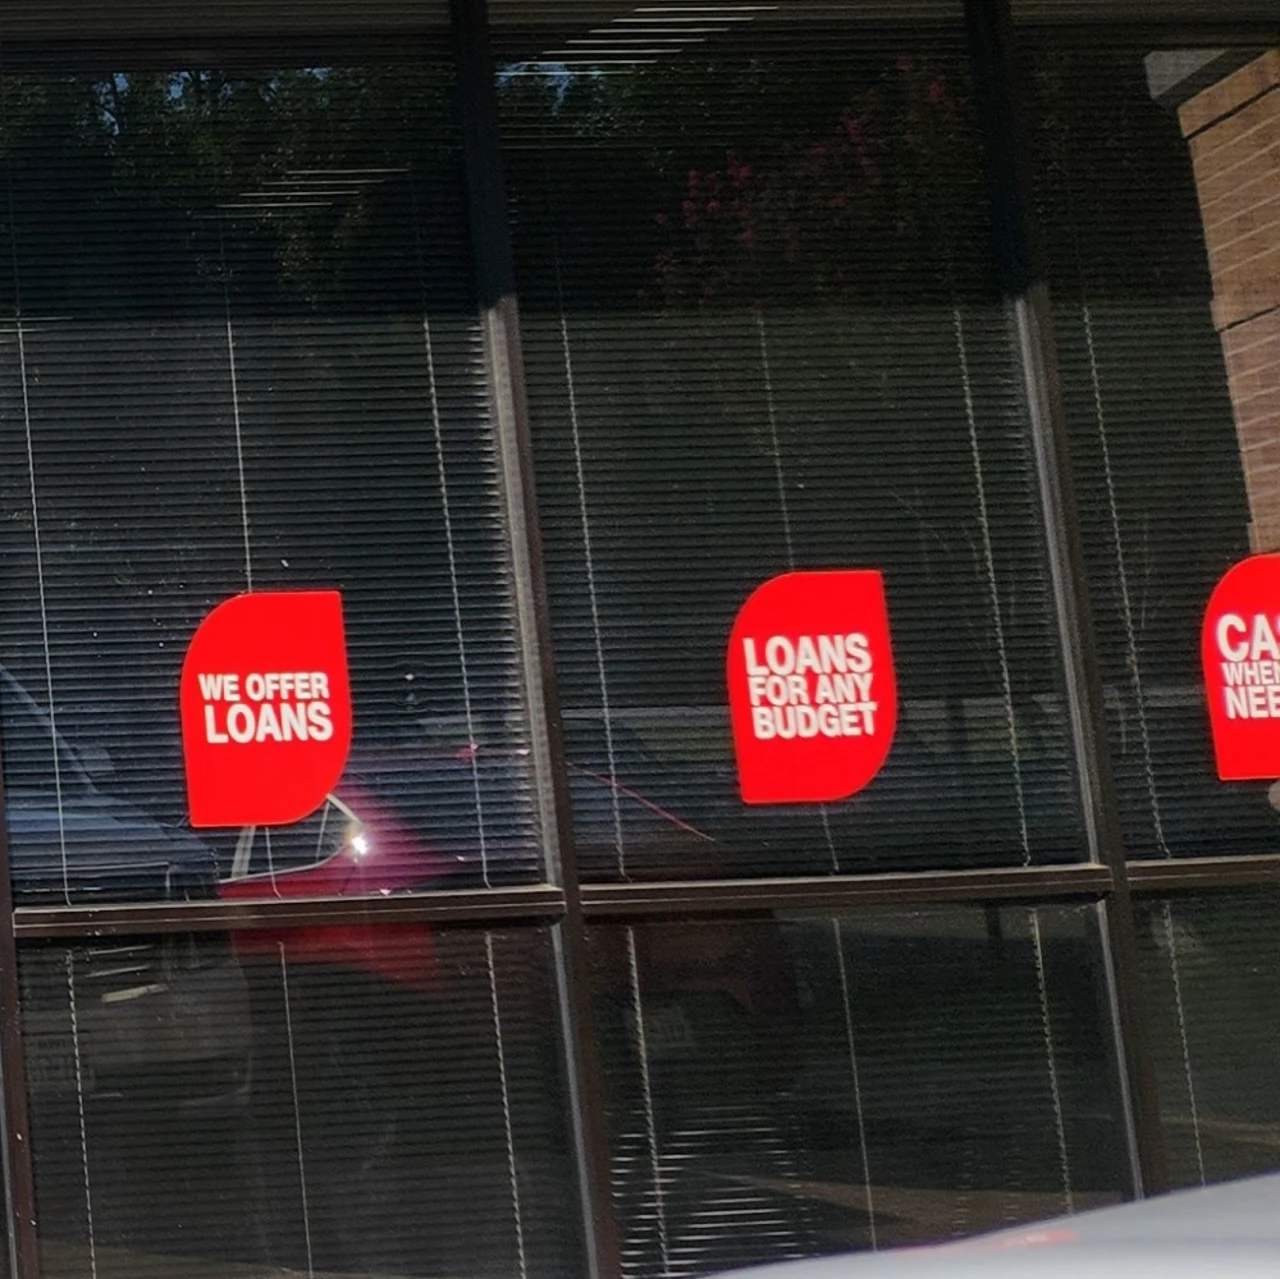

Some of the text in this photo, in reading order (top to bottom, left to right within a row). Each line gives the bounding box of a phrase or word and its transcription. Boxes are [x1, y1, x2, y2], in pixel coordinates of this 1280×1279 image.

[742, 633, 873, 677] LOANS
[1217, 613, 1280, 662] CA
[198, 672, 329, 702] WE OFFER
[749, 673, 873, 706] FOR ANY
[204, 700, 334, 744] LOANS
[751, 701, 877, 740] BUDGET
